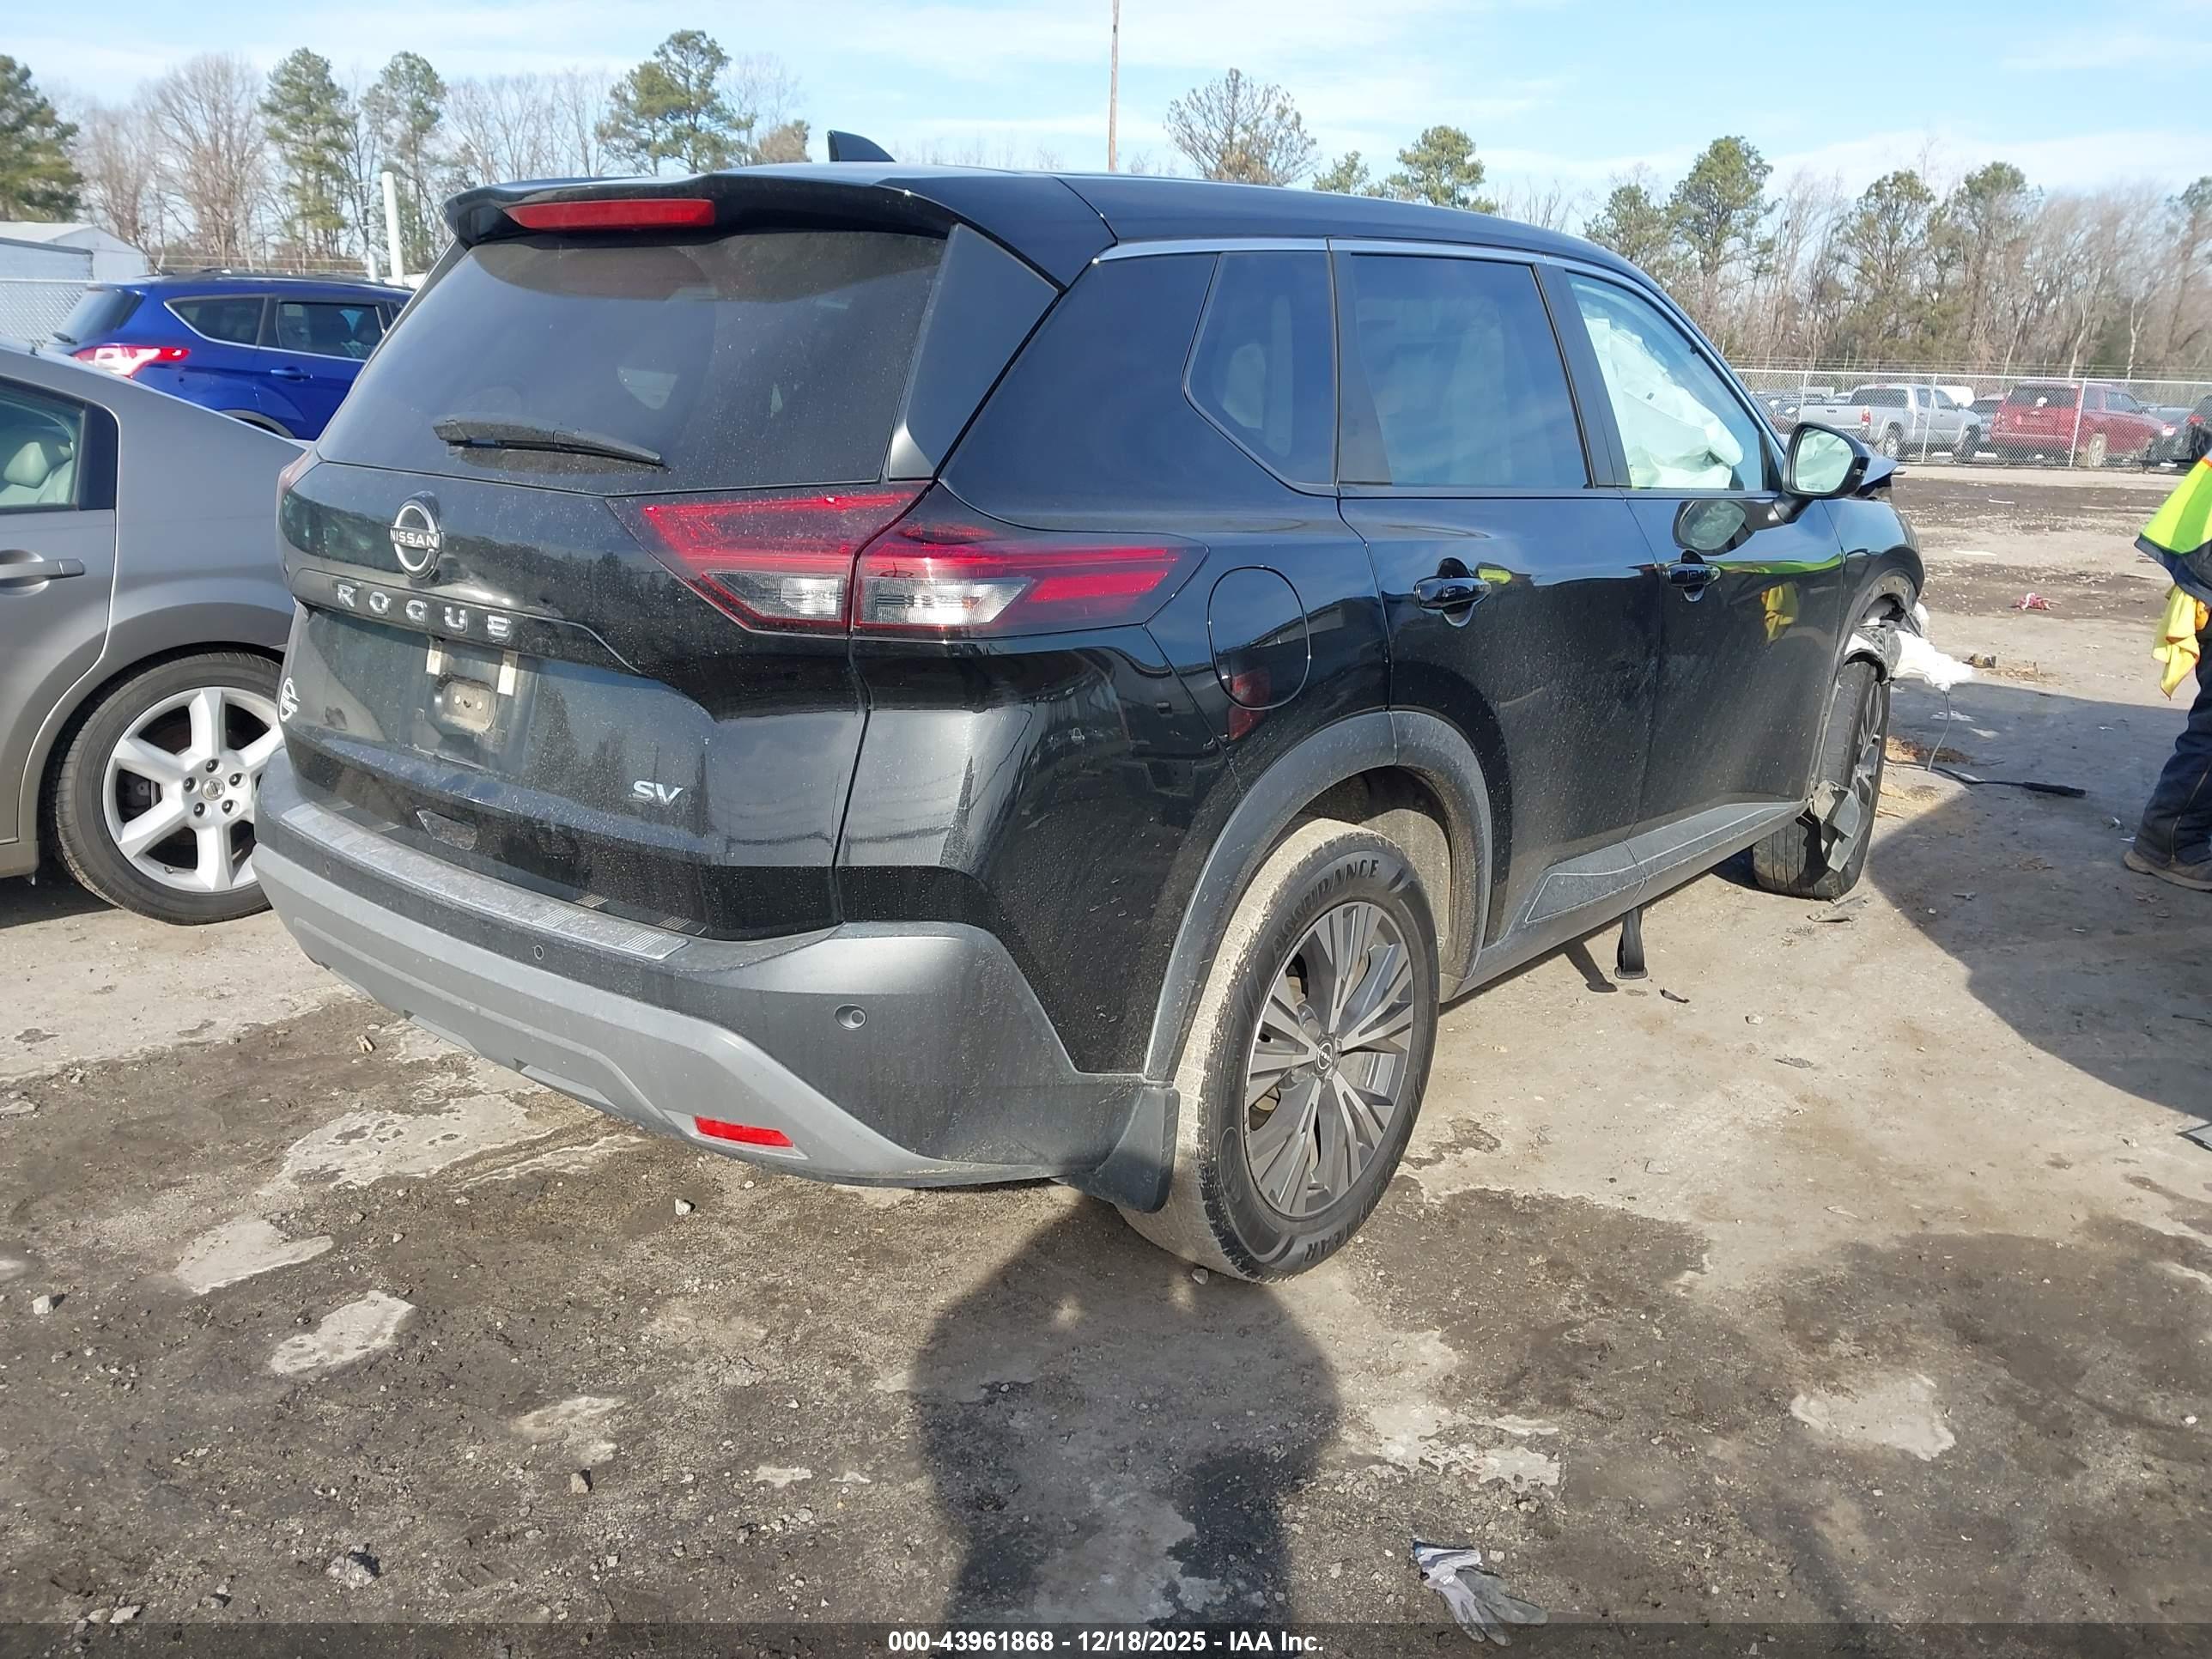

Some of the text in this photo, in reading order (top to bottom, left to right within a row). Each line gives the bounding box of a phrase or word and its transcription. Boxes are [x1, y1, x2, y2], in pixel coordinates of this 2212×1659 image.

[390, 528, 439, 548] NISSAN
[337, 584, 512, 641] ROGUE
[631, 780, 684, 806] SV
